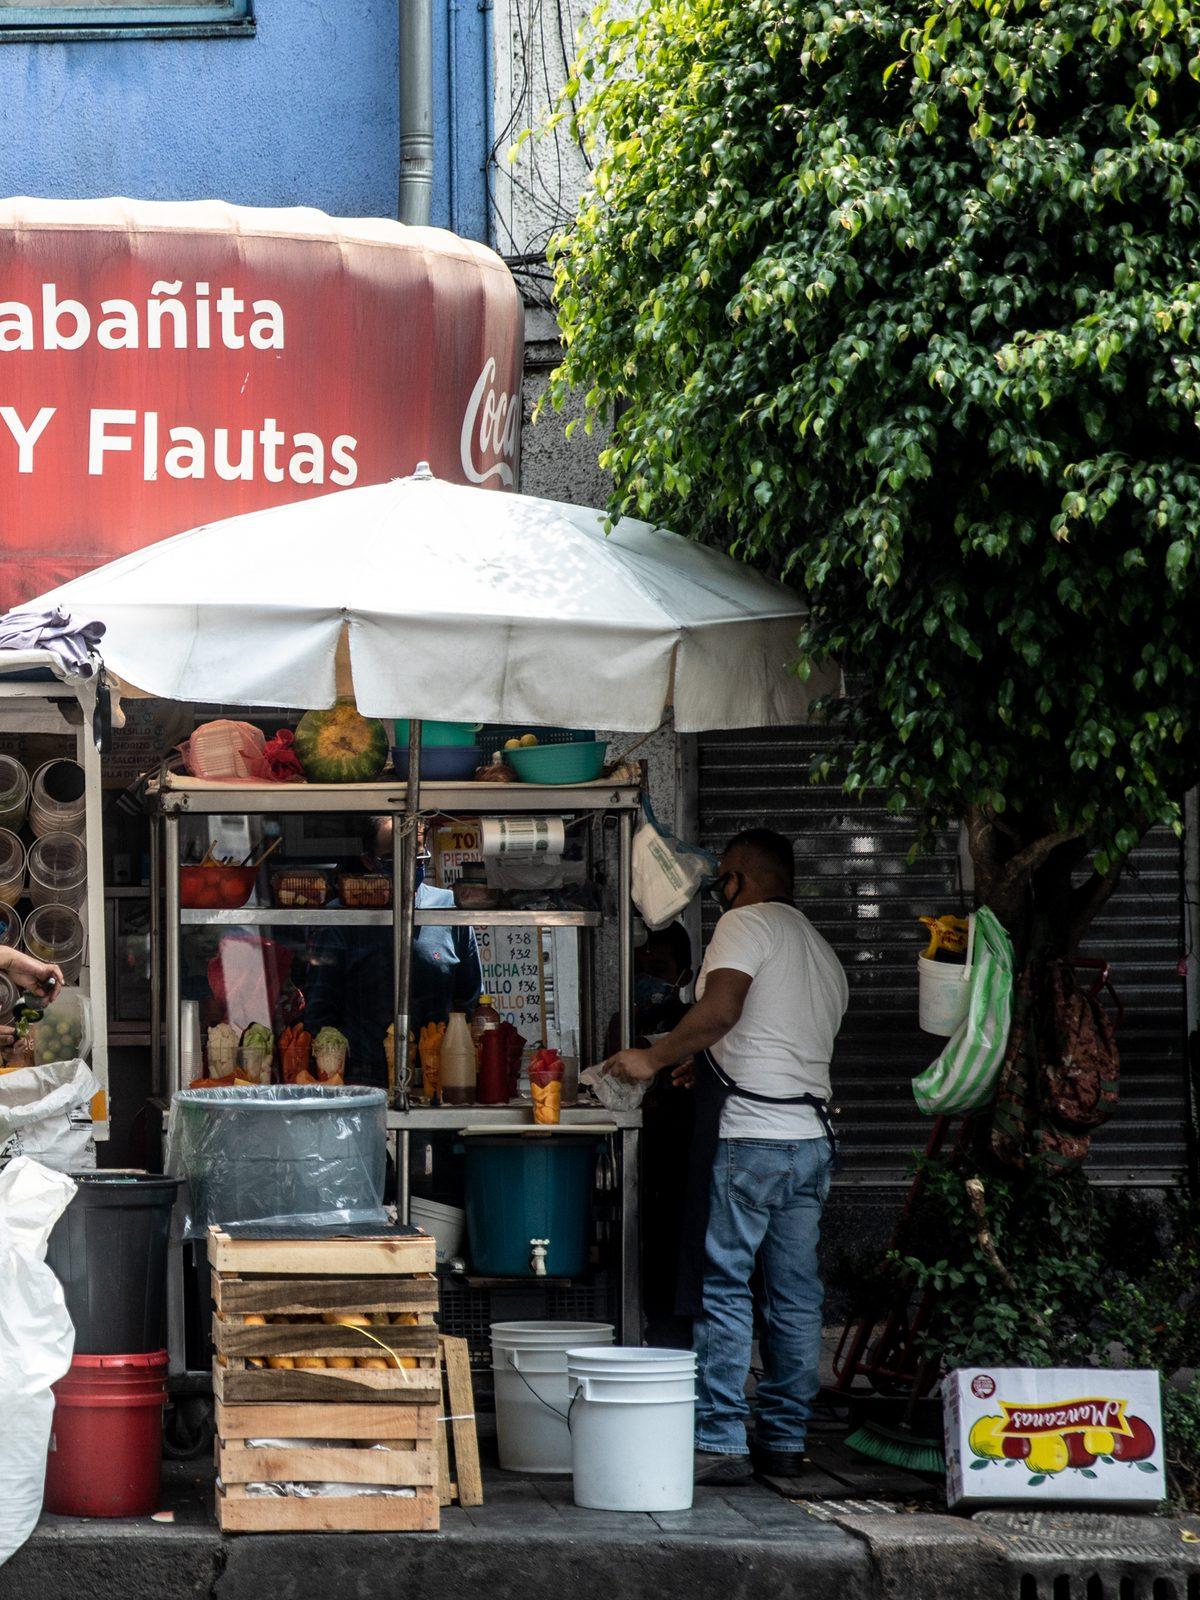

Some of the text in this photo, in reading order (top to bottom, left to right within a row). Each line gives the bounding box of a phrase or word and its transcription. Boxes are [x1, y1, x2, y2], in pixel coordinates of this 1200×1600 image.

[89, 409, 358, 486] Flautas
[453, 832, 479, 849] TO
[483, 964, 520, 978] HICHA
[485, 980, 512, 994] ILLO
[492, 996, 524, 1009] RILLO
[1012, 1401, 1119, 1428] Manzanas
